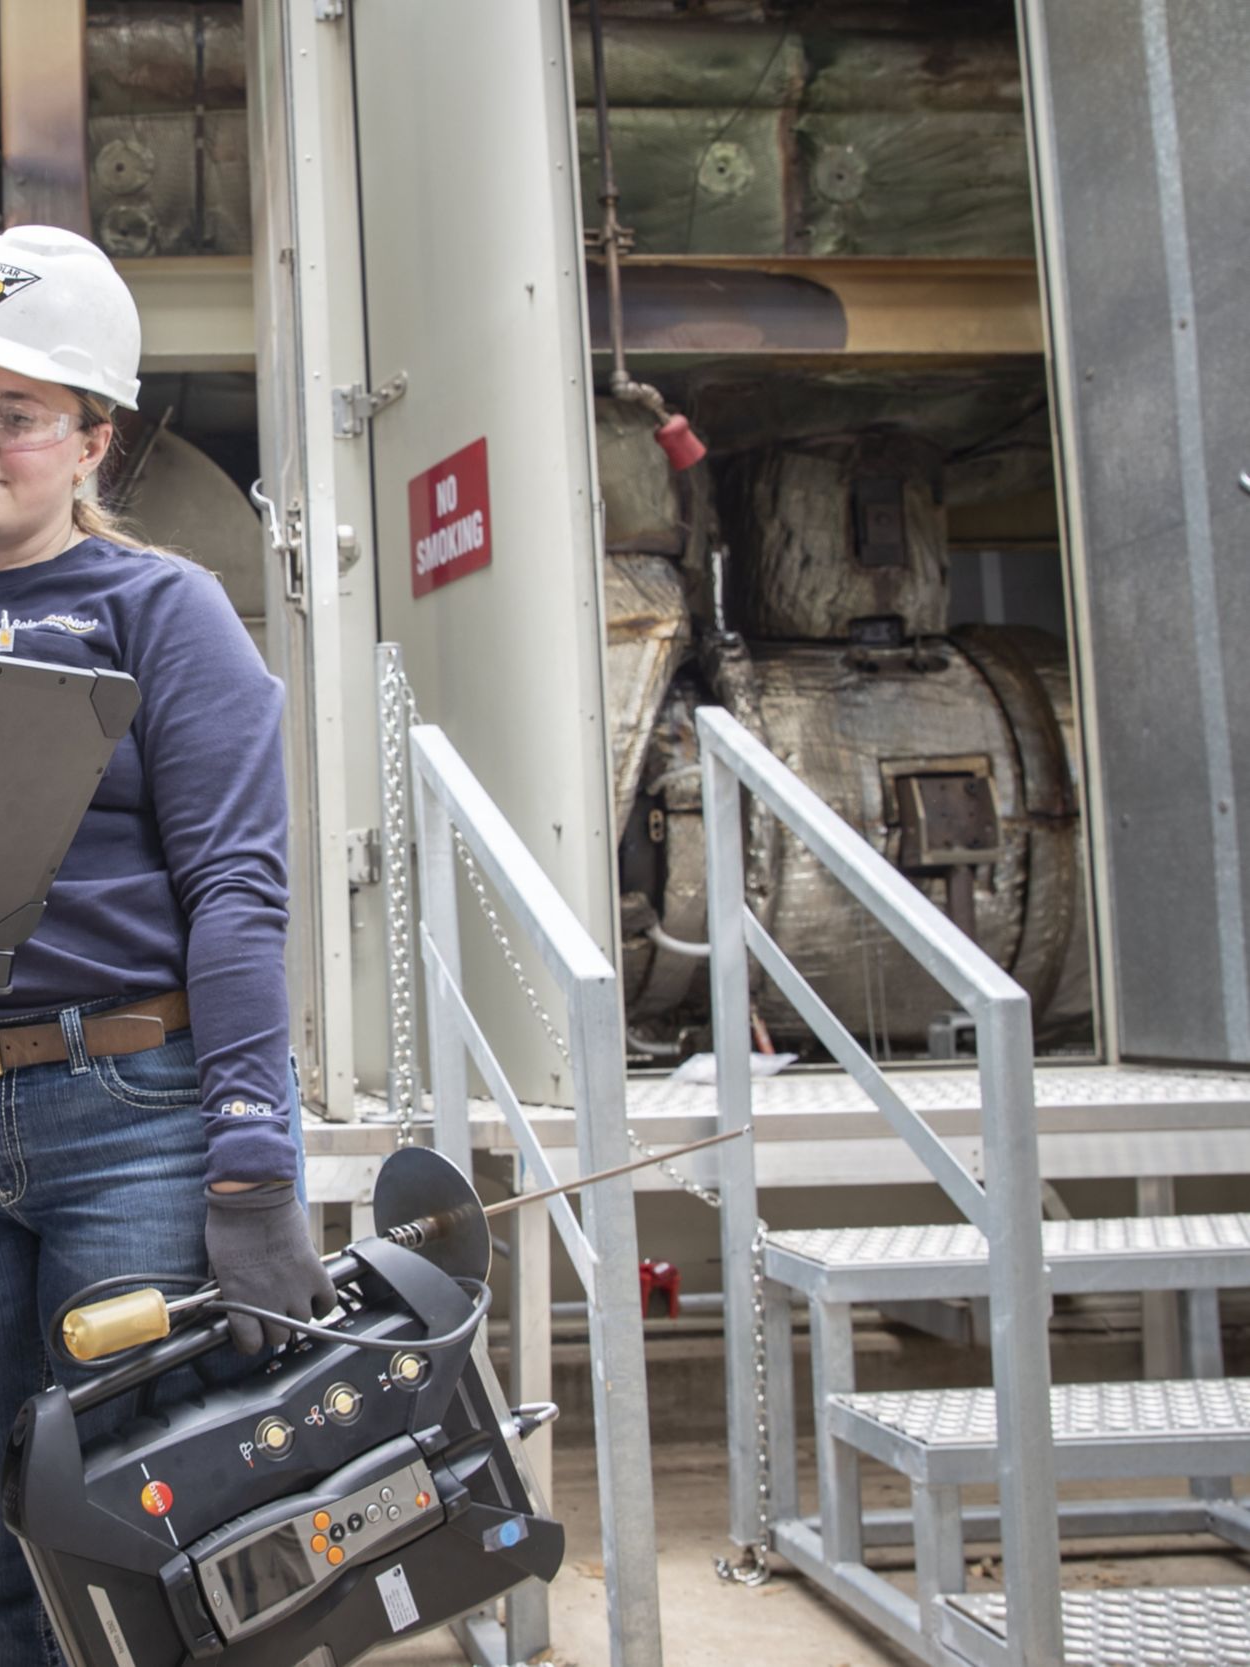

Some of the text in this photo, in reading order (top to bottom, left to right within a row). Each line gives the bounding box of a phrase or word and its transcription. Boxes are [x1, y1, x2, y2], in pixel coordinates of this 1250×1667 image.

[435, 474, 458, 517] NO
[416, 509, 484, 576] SMOKING
[221, 1100, 272, 1117] FORCE
